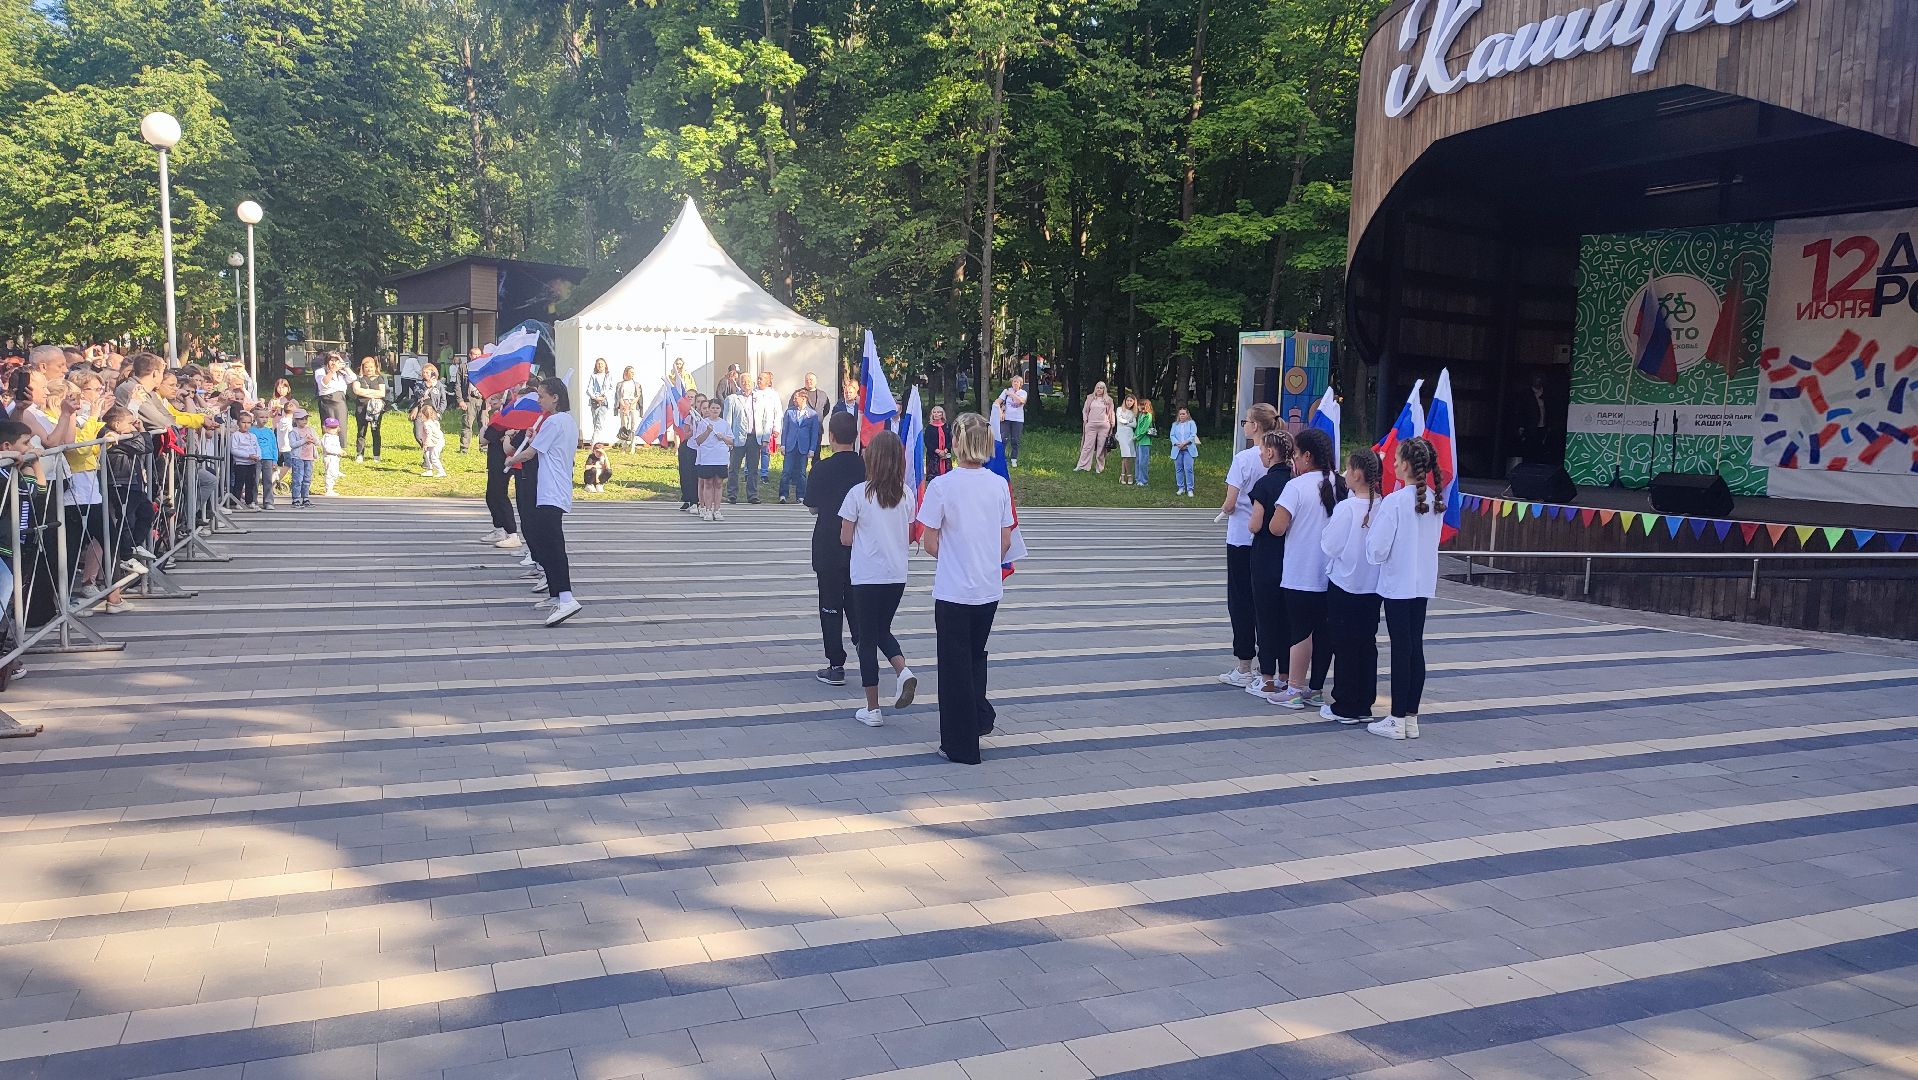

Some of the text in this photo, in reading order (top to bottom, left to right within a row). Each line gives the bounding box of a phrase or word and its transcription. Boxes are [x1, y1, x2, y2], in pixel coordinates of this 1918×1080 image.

[1802, 235, 1880, 303] 12
[1796, 300, 1874, 321] ИЮНЯ
[1872, 275, 1918, 318] Р
[1672, 326, 1700, 341] ТО
